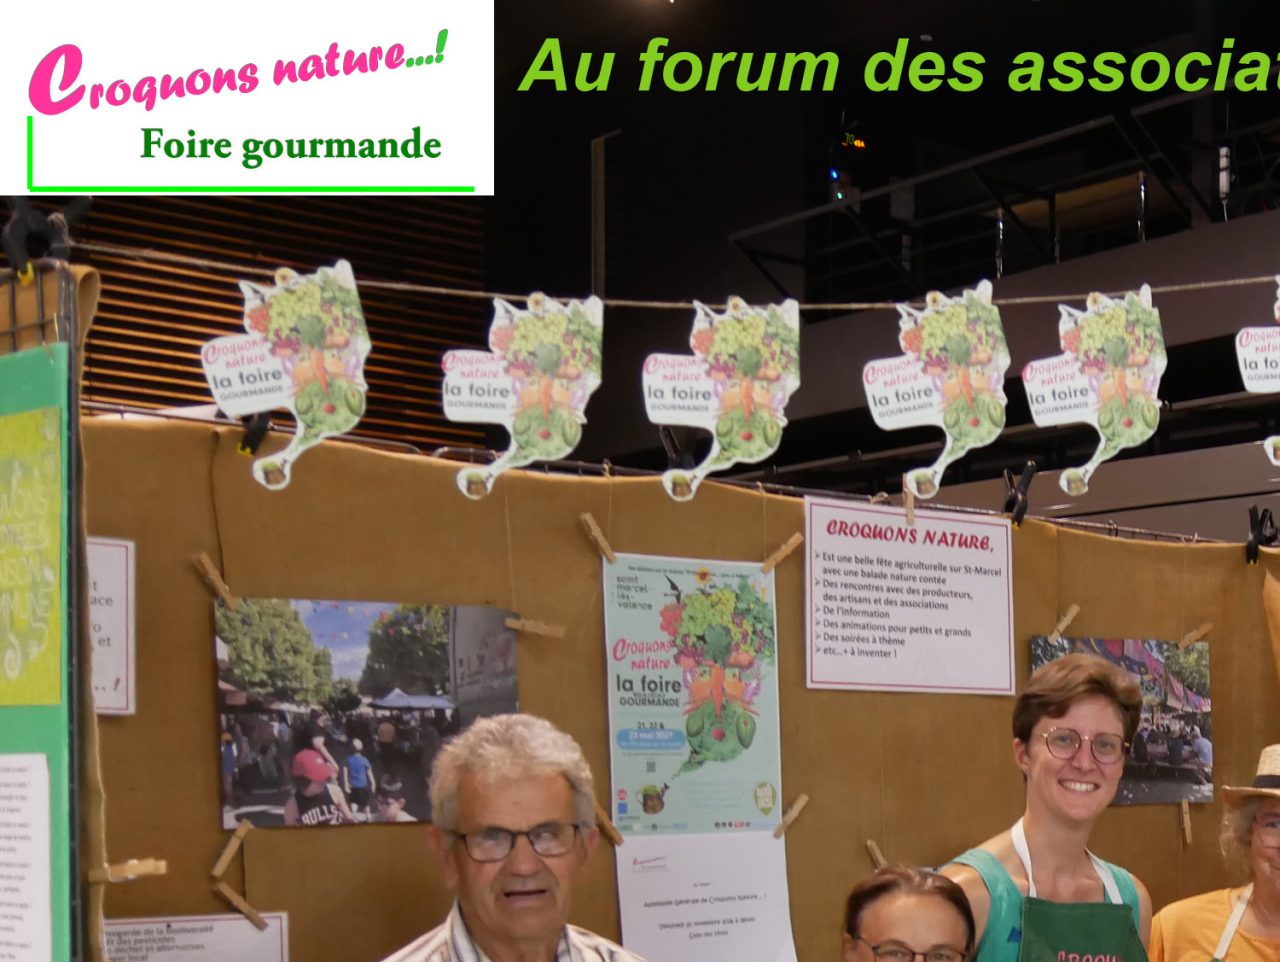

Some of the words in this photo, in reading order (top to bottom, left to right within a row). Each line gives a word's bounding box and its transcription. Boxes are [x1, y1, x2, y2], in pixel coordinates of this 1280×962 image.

[1244, 358, 1258, 370] la
[213, 375, 232, 389] la
[238, 368, 283, 384] foire
[445, 382, 461, 396] la
[469, 381, 510, 398] foire
[648, 386, 664, 399] la
[672, 386, 712, 400] foire
[872, 393, 890, 407] la
[895, 386, 933, 404] foire
[1029, 392, 1046, 406] la
[1051, 386, 1089, 401] foire
[826, 519, 918, 545] CROQUONS
[923, 528, 994, 552] NATURE,
[822, 552, 835, 562] Est
[837, 554, 852, 563] une
[854, 555, 874, 566] belle
[876, 556, 893, 568] fête
[894, 559, 947, 574] agriculturelle
[949, 565, 961, 574] sur
[963, 565, 1002, 577] St-Marcel
[822, 567, 841, 576] avec
[843, 568, 859, 578] une
[861, 568, 888, 580] balade
[890, 572, 917, 582] nature
[919, 574, 946, 584] contée
[823, 579, 838, 588] Des
[840, 581, 884, 593] rencontres
[886, 584, 904, 594] avec
[906, 584, 920, 595] des
[922, 586, 973, 600] producteurs,
[823, 593, 837, 602] des
[839, 594, 871, 605] artisans
[873, 596, 882, 605] et
[884, 596, 898, 607] des
[900, 599, 949, 610] associations
[823, 605, 835, 615] De
[823, 619, 838, 629] Des
[841, 620, 886, 632] animations
[888, 625, 907, 635] pour
[909, 625, 932, 636] petits
[934, 627, 942, 635] et
[945, 627, 971, 638] grands
[823, 632, 839, 642] Des
[841, 633, 870, 644] soirées
[872, 635, 877, 644] à
[879, 635, 906, 646] thème
[857, 649, 891, 659] inventer
[631, 658, 670, 671] nature
[616, 674, 634, 692] la
[641, 673, 681, 692] foire
[619, 697, 679, 708] GOURMANDE
